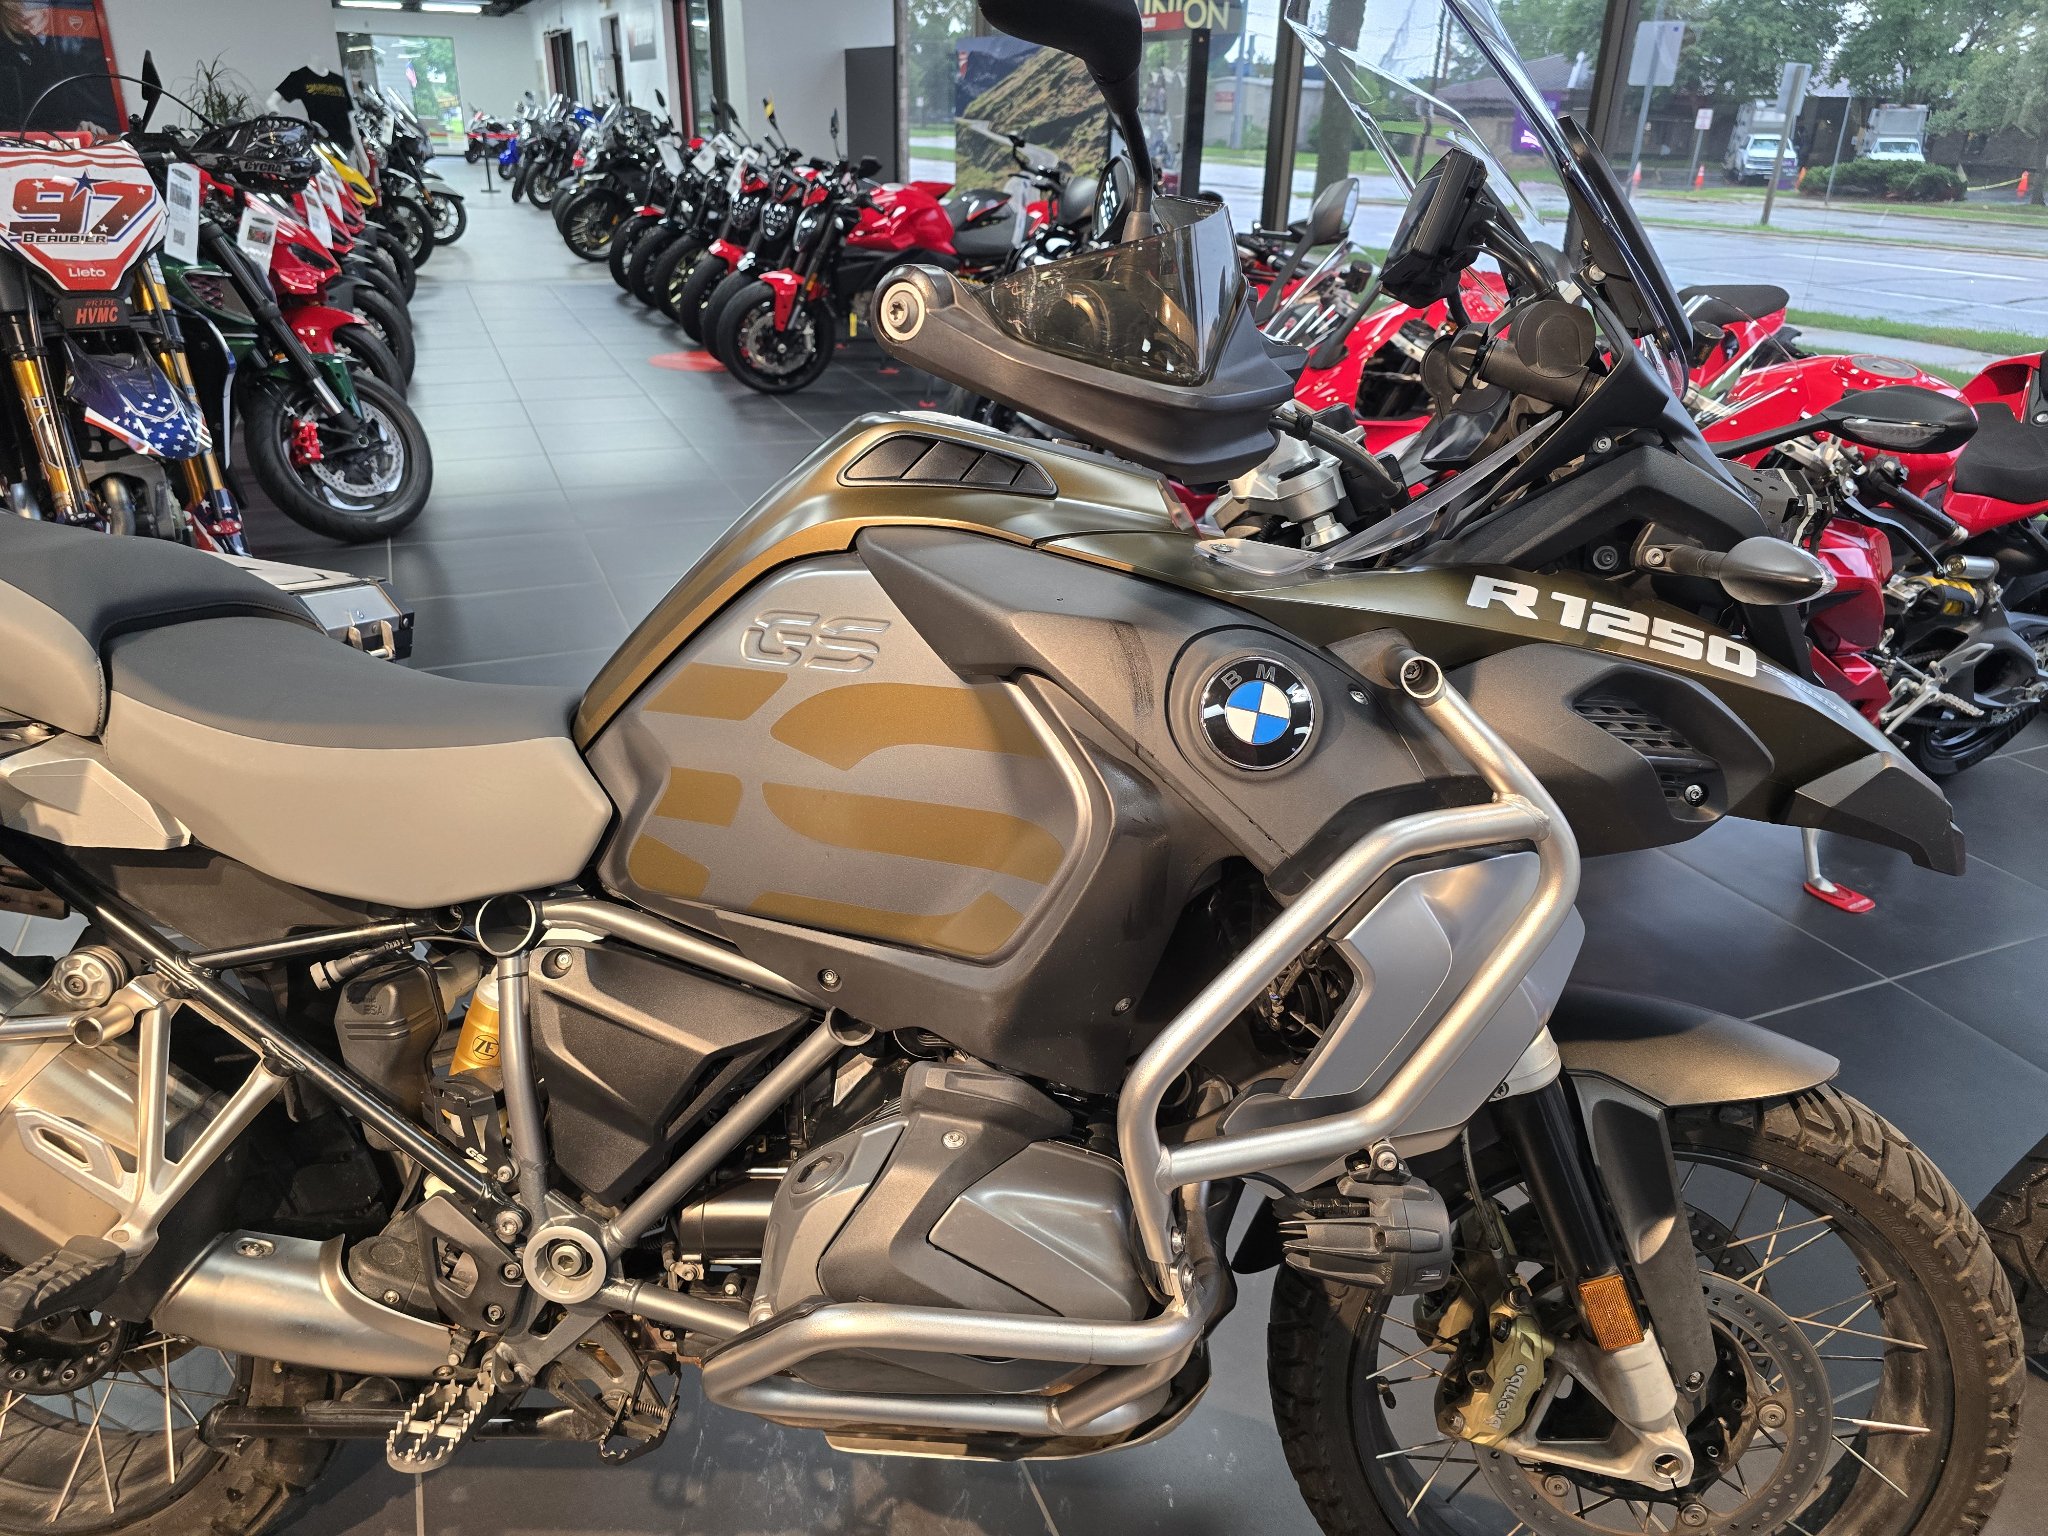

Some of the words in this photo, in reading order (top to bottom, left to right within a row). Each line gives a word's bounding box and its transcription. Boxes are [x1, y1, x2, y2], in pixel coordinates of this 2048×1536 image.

[243, 160, 282, 173] CYCRA
[9, 175, 154, 238] 97
[76, 305, 119, 325] HVMC
[740, 609, 890, 673] GS
[1466, 584, 1539, 620] R
[1550, 591, 1757, 678] 1250
[1220, 663, 1312, 704] BMW
[475, 1038, 496, 1053] ZF
[465, 1146, 488, 1164] GS
[1483, 1364, 1528, 1429] brembo
